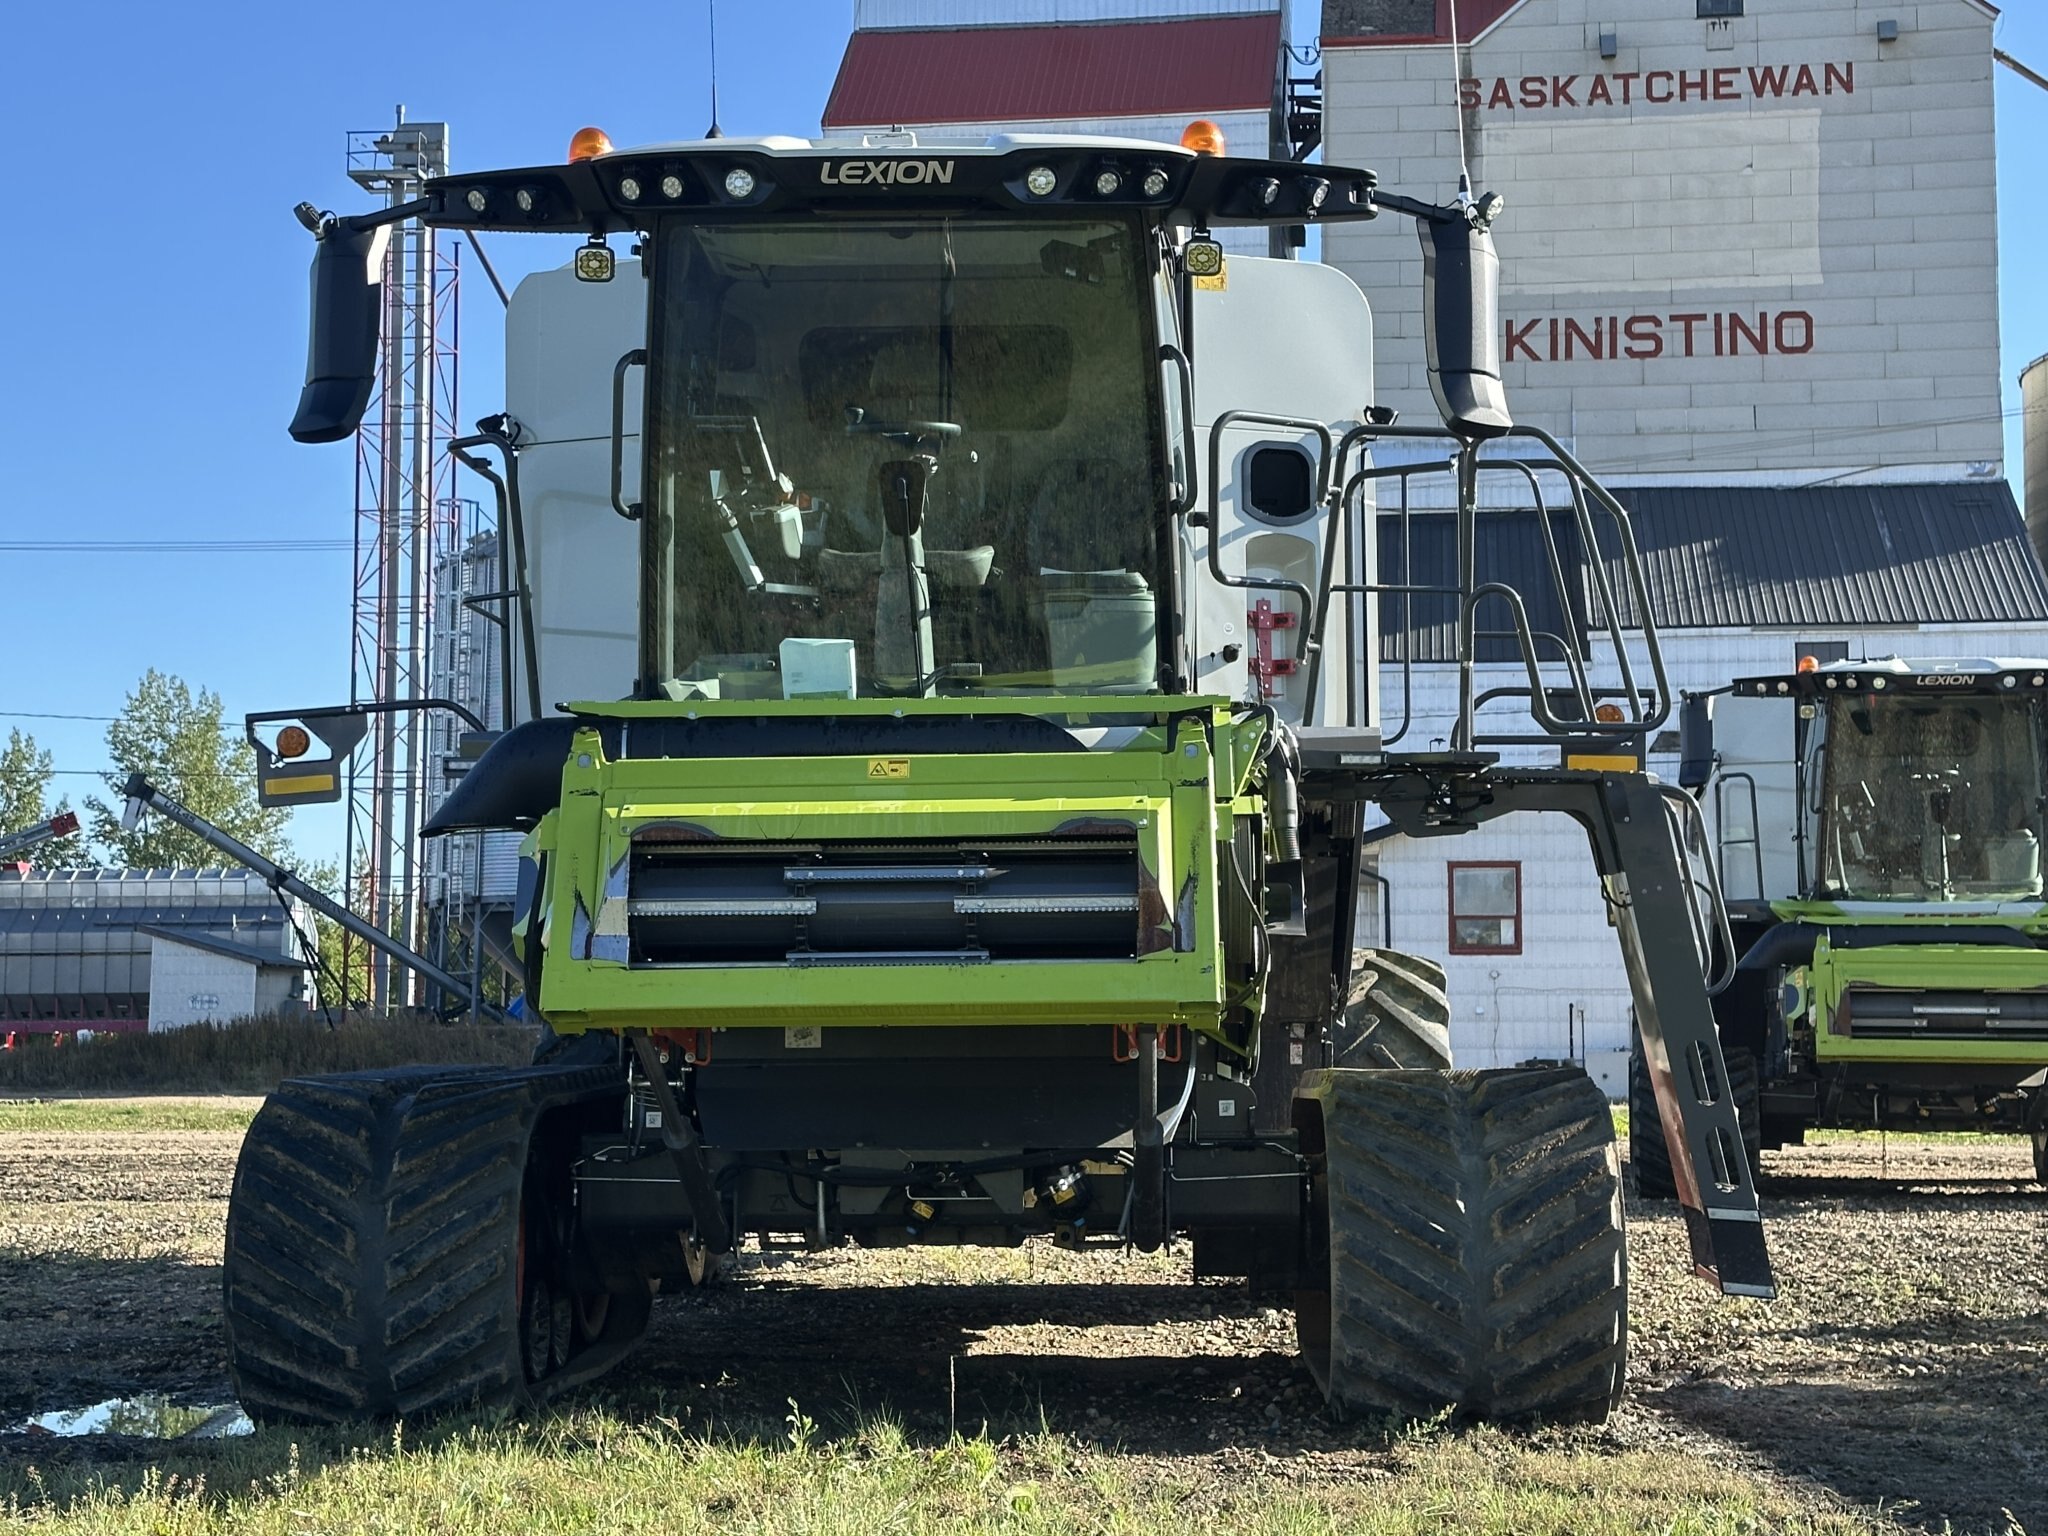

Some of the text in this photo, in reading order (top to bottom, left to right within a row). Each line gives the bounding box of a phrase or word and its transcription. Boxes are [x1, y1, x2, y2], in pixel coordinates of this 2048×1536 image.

[1455, 61, 1854, 110] SASKATCHEWAN
[820, 160, 955, 184] LEXION
[1505, 310, 1814, 362] KINISTINO
[1916, 675, 1975, 686] LEXION
